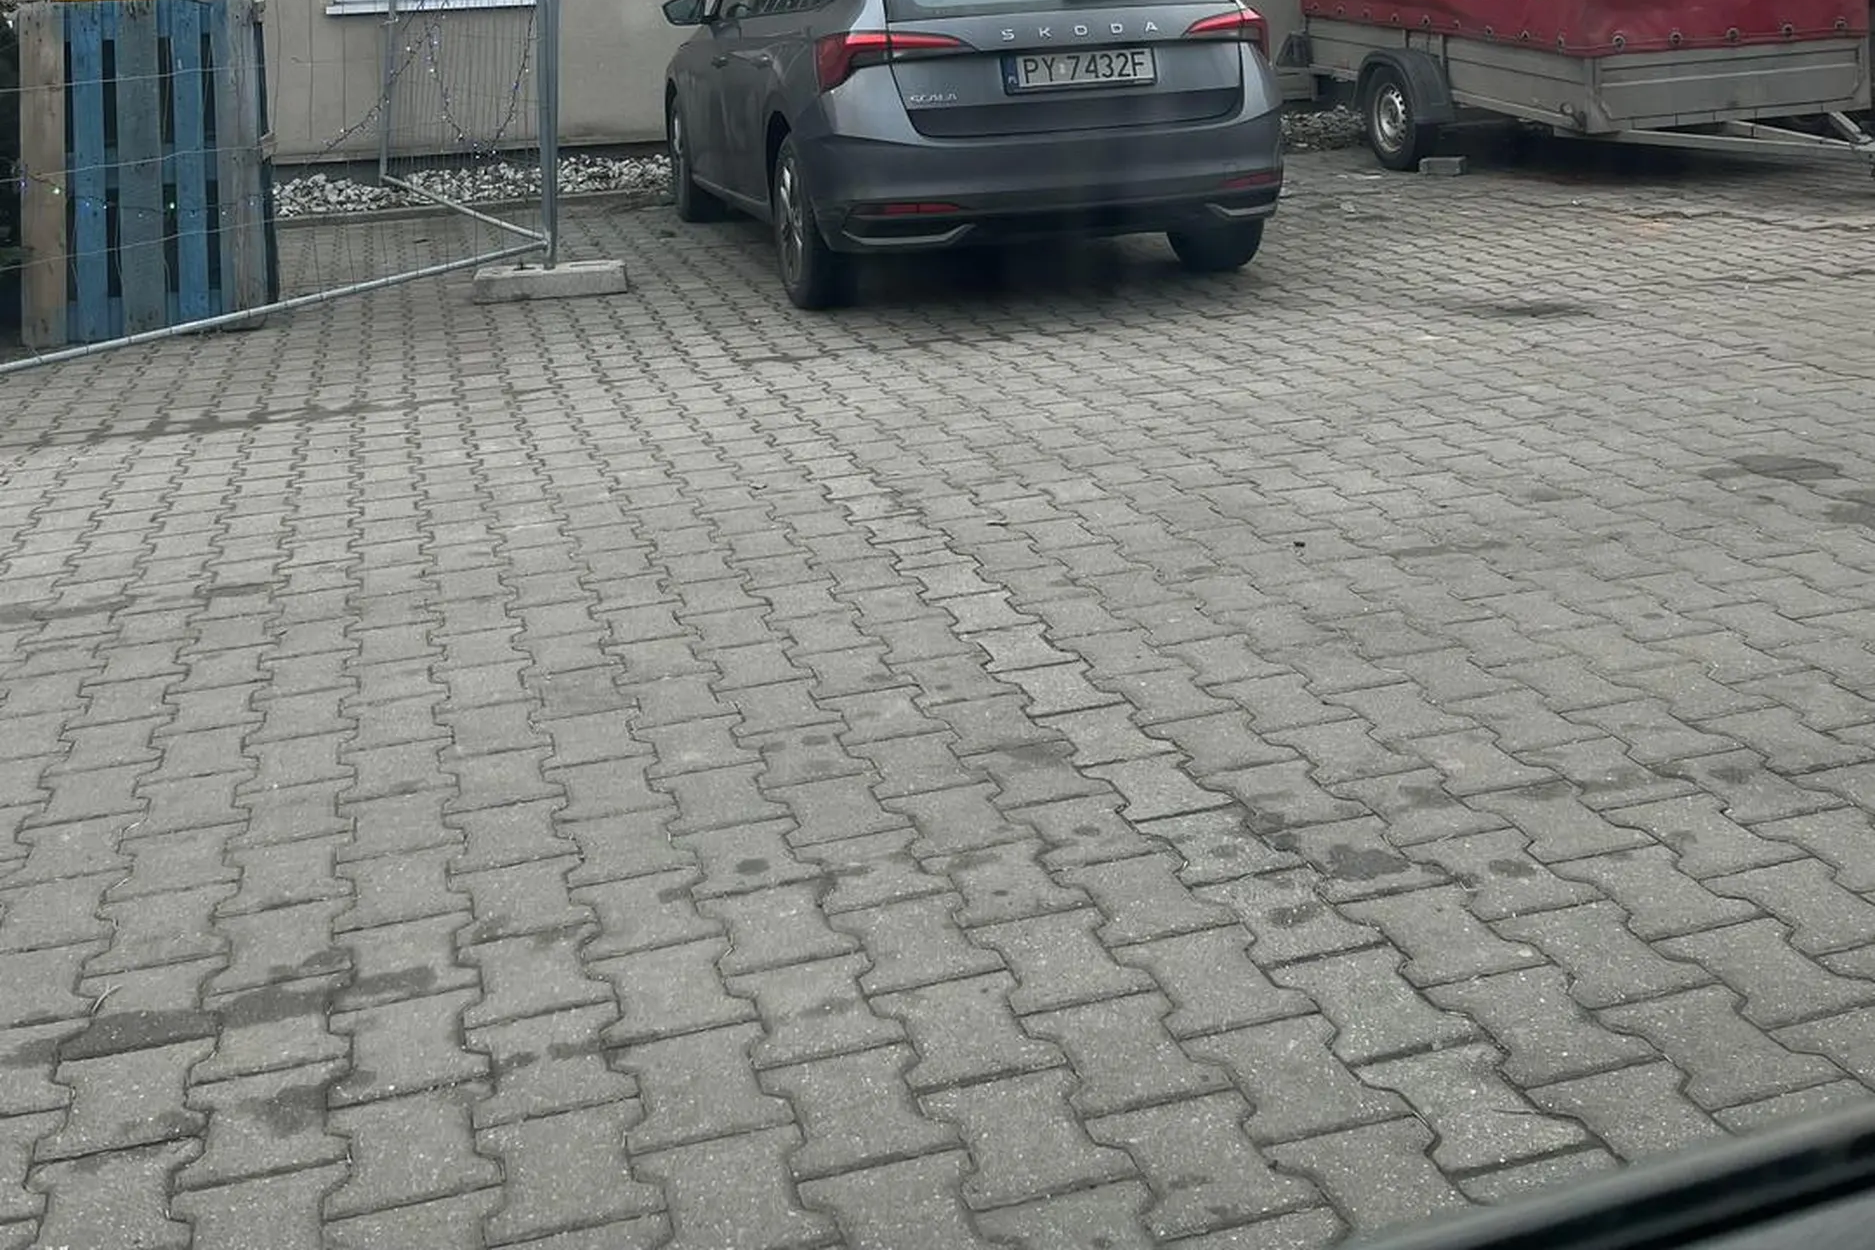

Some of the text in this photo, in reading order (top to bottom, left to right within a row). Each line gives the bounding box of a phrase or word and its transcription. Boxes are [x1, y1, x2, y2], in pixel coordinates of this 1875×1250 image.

[1001, 21, 1158, 41] SKODA
[1023, 51, 1146, 84] PY 7432F
